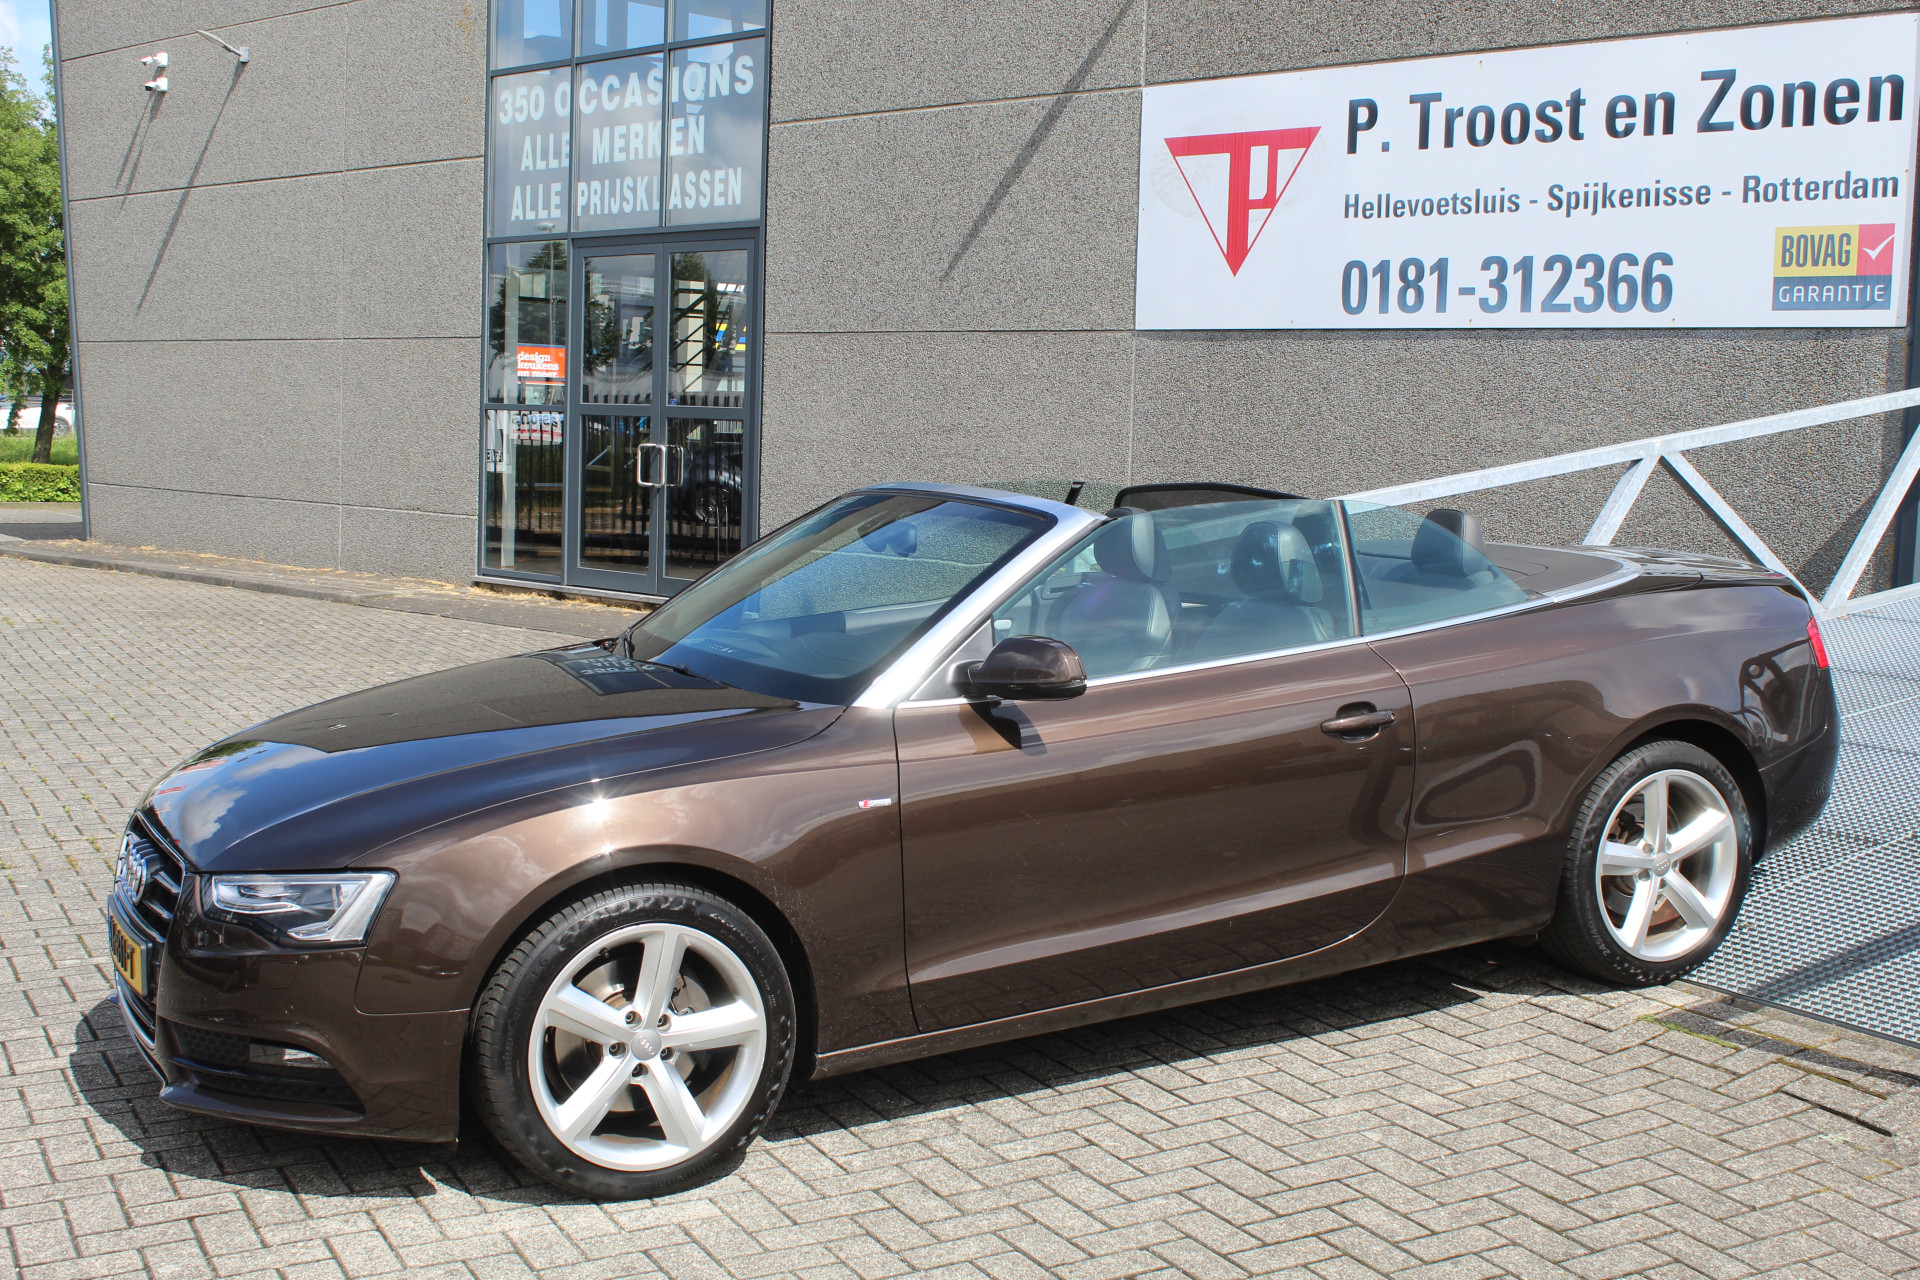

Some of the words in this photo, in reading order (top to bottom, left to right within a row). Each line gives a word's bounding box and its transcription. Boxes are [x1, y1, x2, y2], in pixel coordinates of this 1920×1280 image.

[499, 85, 545, 124] 350
[554, 55, 754, 118] OCCASIONS
[1346, 98, 1391, 154] P.
[1409, 88, 1586, 150] Troost
[1605, 90, 1676, 139] en
[1697, 69, 1905, 133] Zonen
[520, 131, 570, 172] ALLE
[592, 115, 705, 165] MERKEN
[510, 182, 562, 222] ALLE
[577, 167, 742, 217] PRIJSKLASSEN
[1343, 187, 1520, 220] Hellevoetsluis
[1547, 179, 1711, 218] Spijkenisse
[1742, 171, 1899, 203] Rotterdam
[1780, 233, 1852, 268] BOVAG
[1341, 252, 1674, 315] 0181-312366
[1778, 285, 1886, 303] GARANTIE
[517, 351, 551, 363] design
[518, 360, 560, 371] keukens
